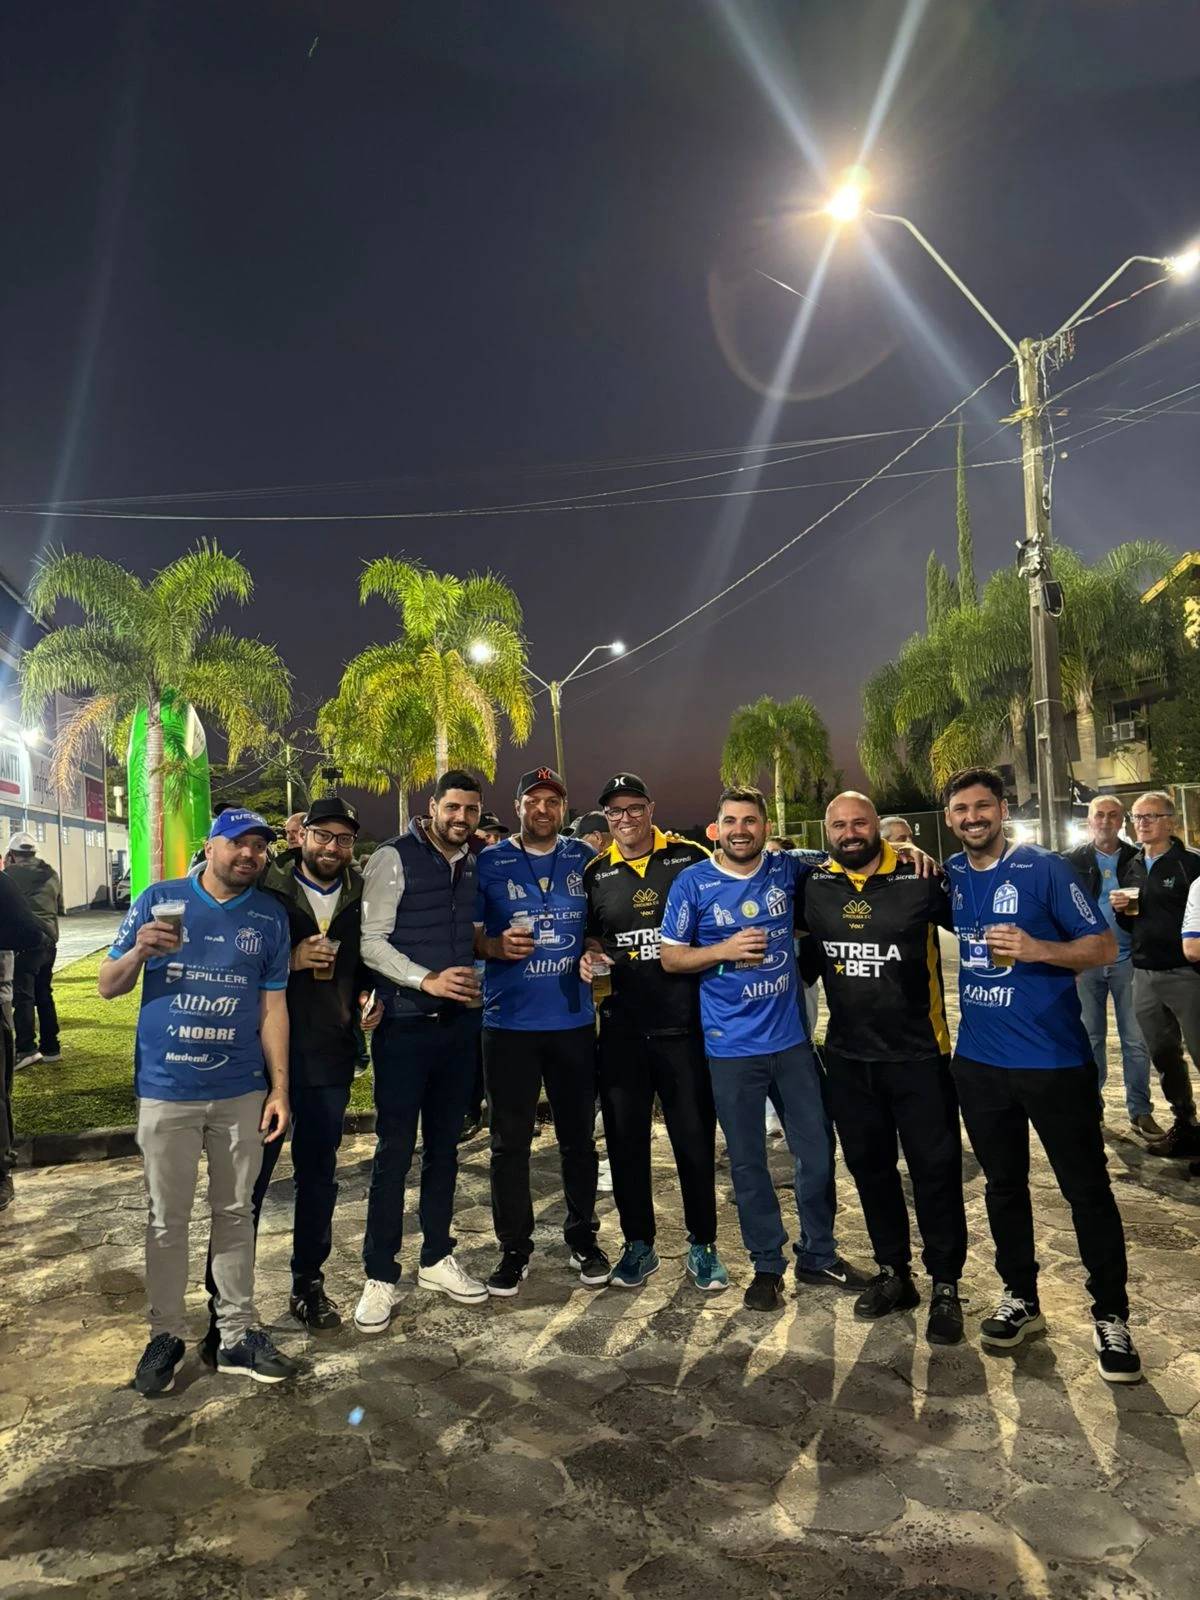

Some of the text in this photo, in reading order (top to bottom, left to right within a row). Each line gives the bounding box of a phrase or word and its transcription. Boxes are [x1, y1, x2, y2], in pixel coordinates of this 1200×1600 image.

[822, 940, 902, 962] ESTRELA
[523, 956, 575, 974] Althoff
[845, 959, 885, 978] BET
[185, 970, 248, 985] SPILLERE
[741, 972, 790, 998] Althoff
[169, 993, 241, 1016] Althoff
[179, 1025, 236, 1041] NOBRE
[165, 1052, 209, 1063] Mademil
